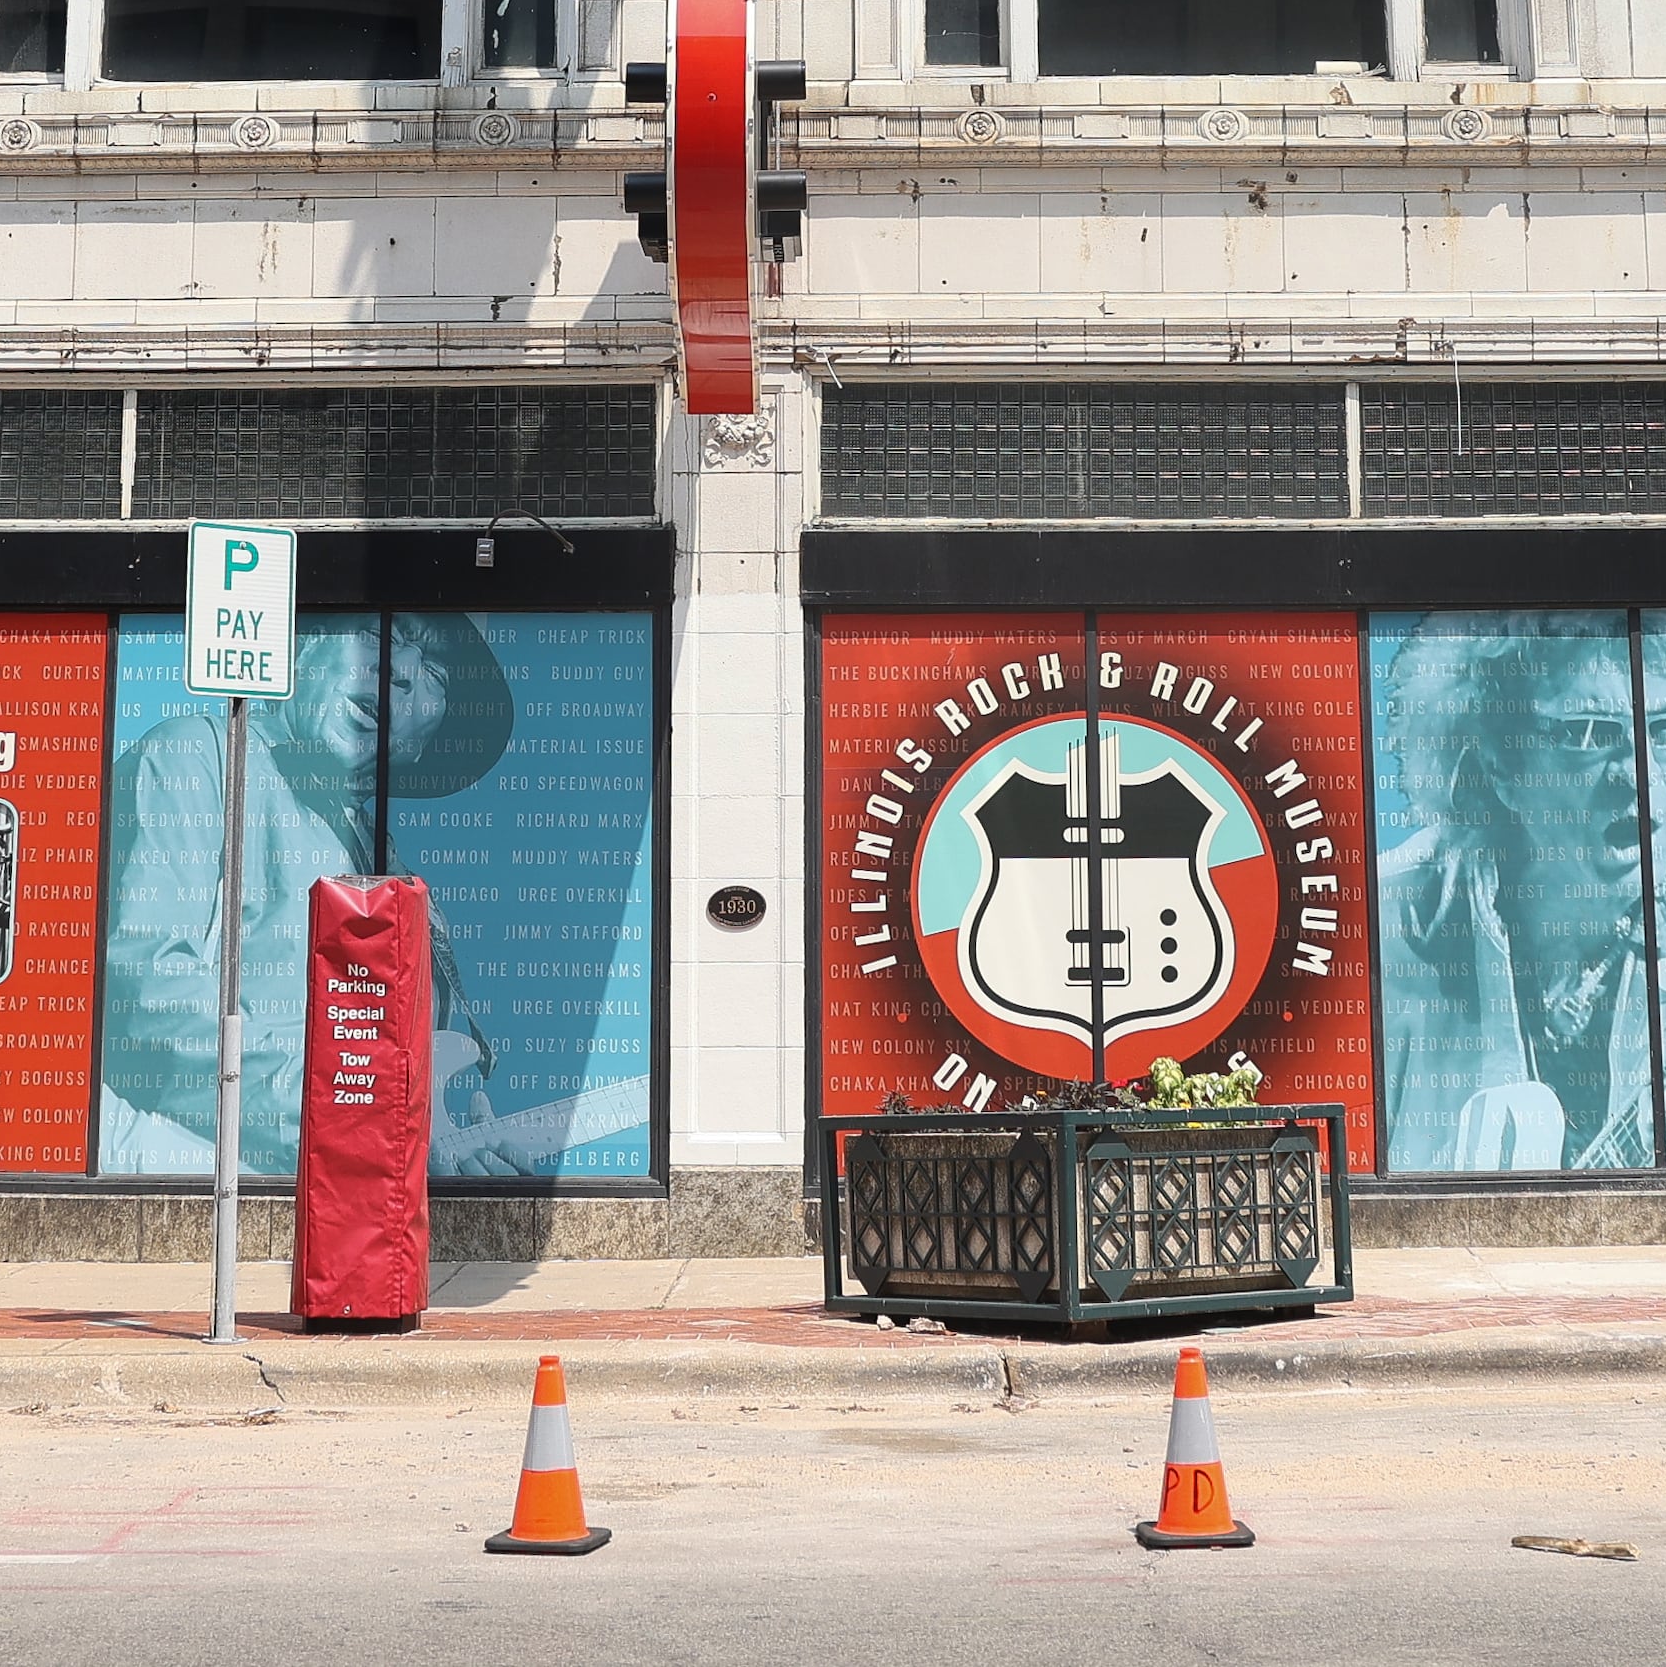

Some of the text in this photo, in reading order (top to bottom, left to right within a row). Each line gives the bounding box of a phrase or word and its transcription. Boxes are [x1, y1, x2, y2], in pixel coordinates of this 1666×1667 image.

[224, 539, 259, 590] P
[217, 608, 264, 640] PAY
[0, 629, 51, 643] CHAKA
[60, 630, 102, 643] KHAN
[538, 630, 645, 644] CHEAP TRICK
[207, 648, 272, 681] HERE
[43, 666, 99, 680] CURTIS
[551, 666, 644, 681] BUDDY GUY
[829, 664, 1353, 681] THE BUCKINGHAMS NEW COLONY
[527, 702, 644, 717] OFF BROADWAY
[1266, 701, 1354, 717] KING COLE
[506, 739, 644, 754] MATERIAL ISSUE
[1292, 737, 1356, 751] CHANCE
[35, 775, 96, 789] VEDDER
[500, 776, 643, 791] REO SPEEDWAGON
[398, 812, 642, 828] SAM COOKE RICHARD MARX
[851, 652, 1339, 977] ILLINOIS ROCK & ROLL MUSEUM
[518, 887, 642, 902] URGE OVERKILL
[719, 900, 756, 914] 1930
[348, 963, 368, 977] No
[327, 980, 386, 997] Parking
[37, 996, 85, 1011] TRICK
[1301, 1000, 1365, 1014] VEDDER
[327, 1006, 384, 1022] Special
[333, 1026, 378, 1040] Event
[339, 1052, 371, 1067] Tow
[333, 1072, 375, 1088] Away
[1295, 1074, 1366, 1089] CHICAGO
[334, 1090, 374, 1105] Zone
[23, 1108, 83, 1124] COLONY
